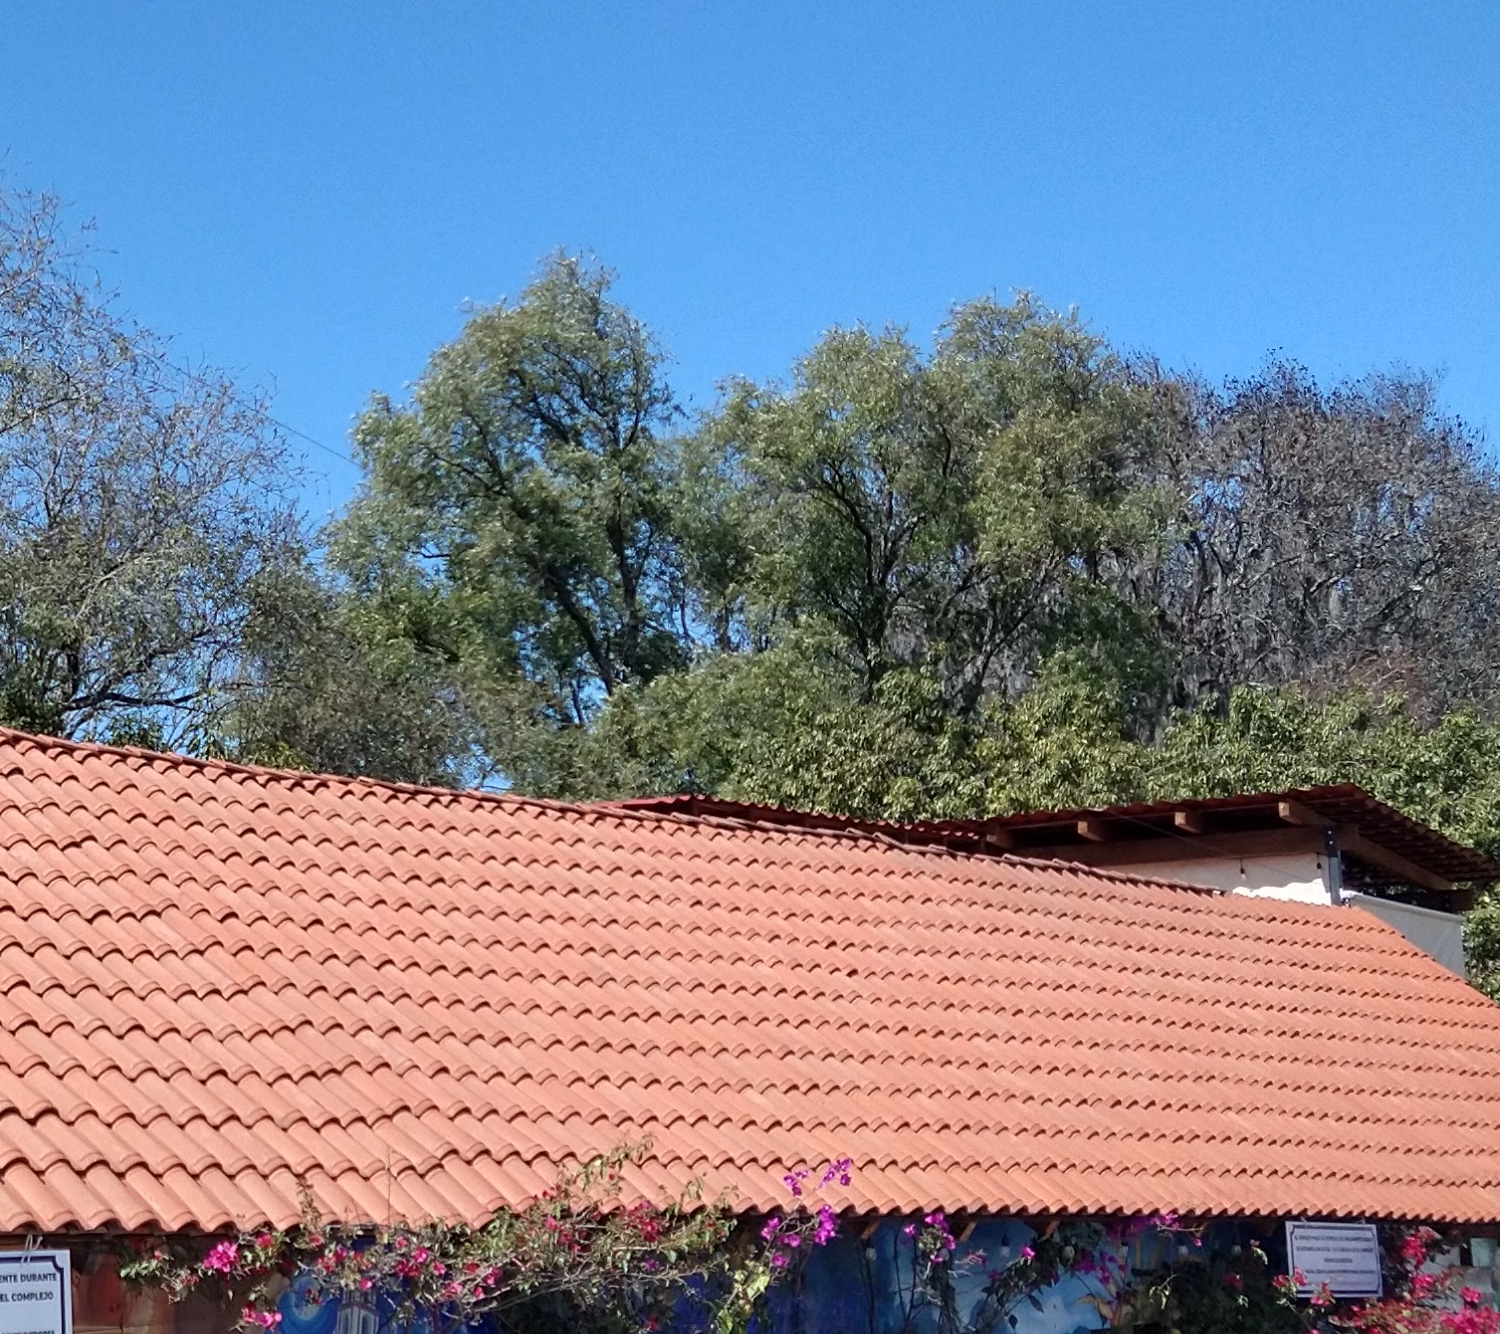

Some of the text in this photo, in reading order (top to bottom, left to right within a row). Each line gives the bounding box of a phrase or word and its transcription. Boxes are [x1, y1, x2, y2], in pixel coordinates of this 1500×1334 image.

[20, 1272, 57, 1283] DURANTE
[0, 1293, 10, 1303] EL
[11, 1291, 54, 1302] COMPLEJO
